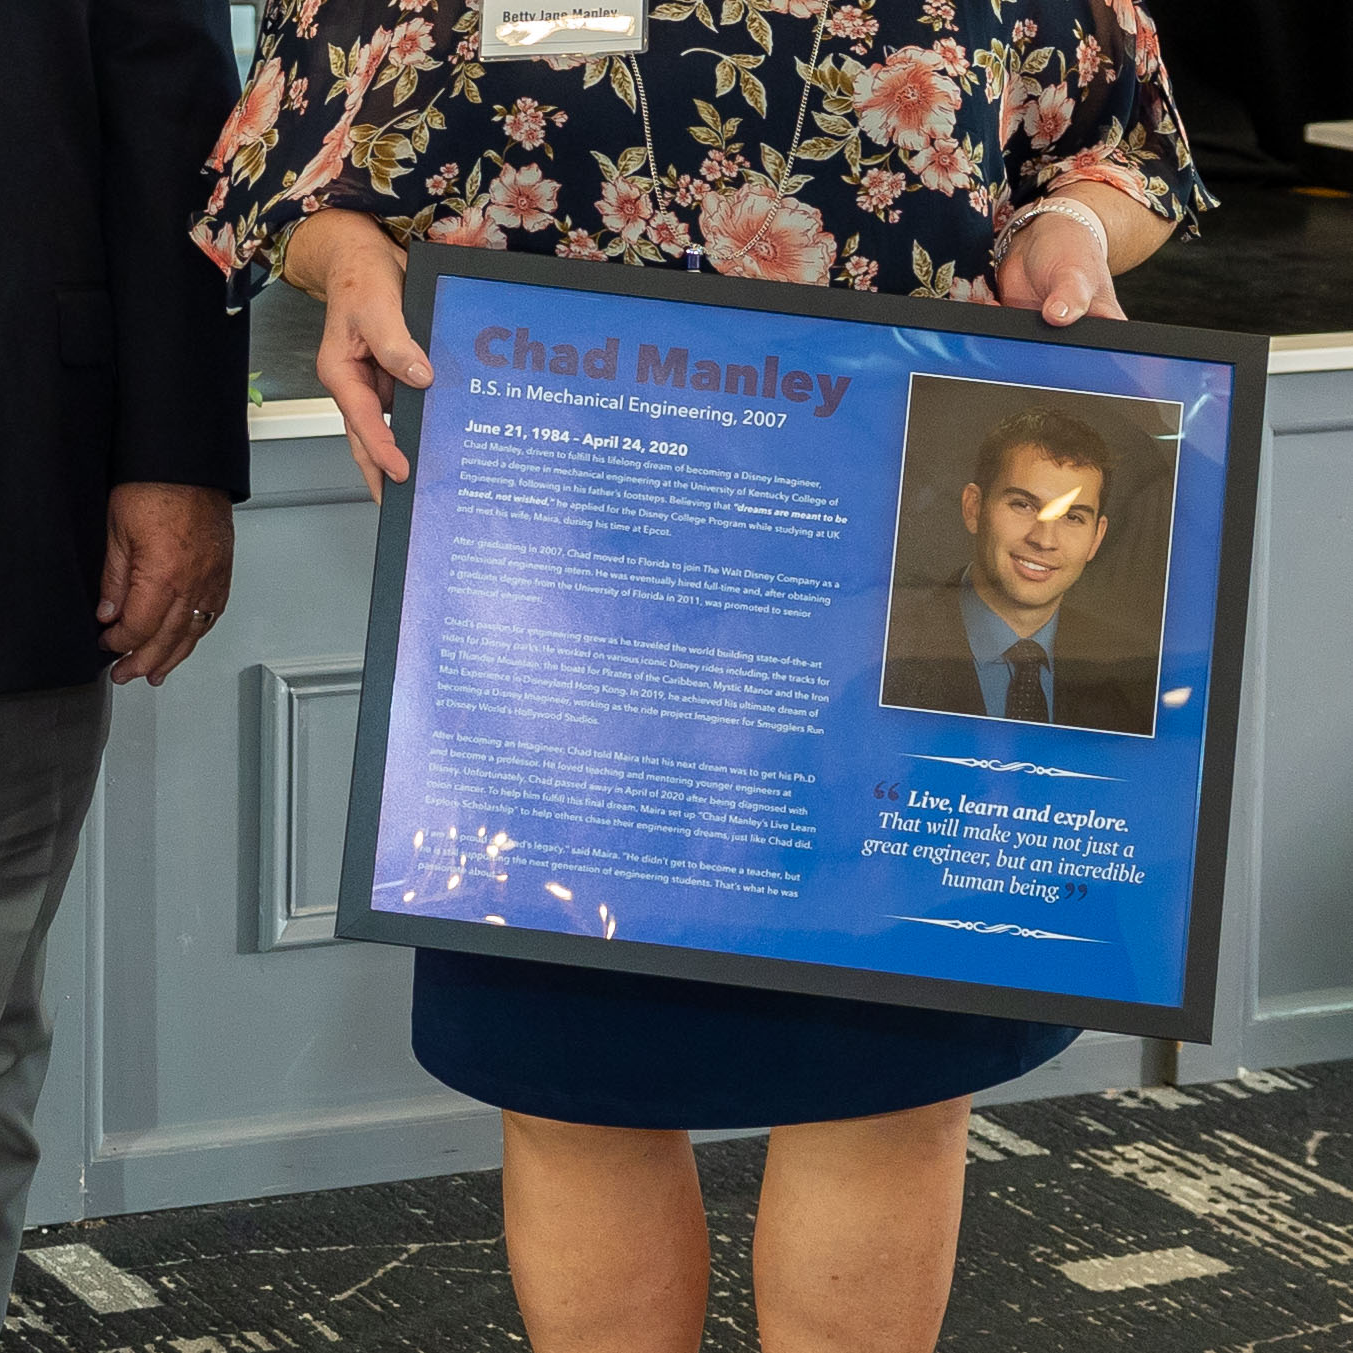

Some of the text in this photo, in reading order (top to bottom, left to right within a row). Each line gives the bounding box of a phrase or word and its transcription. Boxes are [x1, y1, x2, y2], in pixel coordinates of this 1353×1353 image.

[473, 325, 852, 418] Chad Manley
[470, 378, 787, 428] B.S. in Mechanical Engineering, 2007
[465, 419, 501, 435] June
[504, 424, 527, 440] 21,
[532, 427, 570, 443] 1984
[582, 433, 619, 449] April
[622, 437, 645, 453] 24,
[649, 440, 688, 457] 2020
[878, 811, 1135, 858] That will make you not just a
[907, 790, 1129, 833] Live, learn and explore.
[861, 839, 1145, 885] great engineer, but an incredible
[941, 867, 1060, 904] human being.
